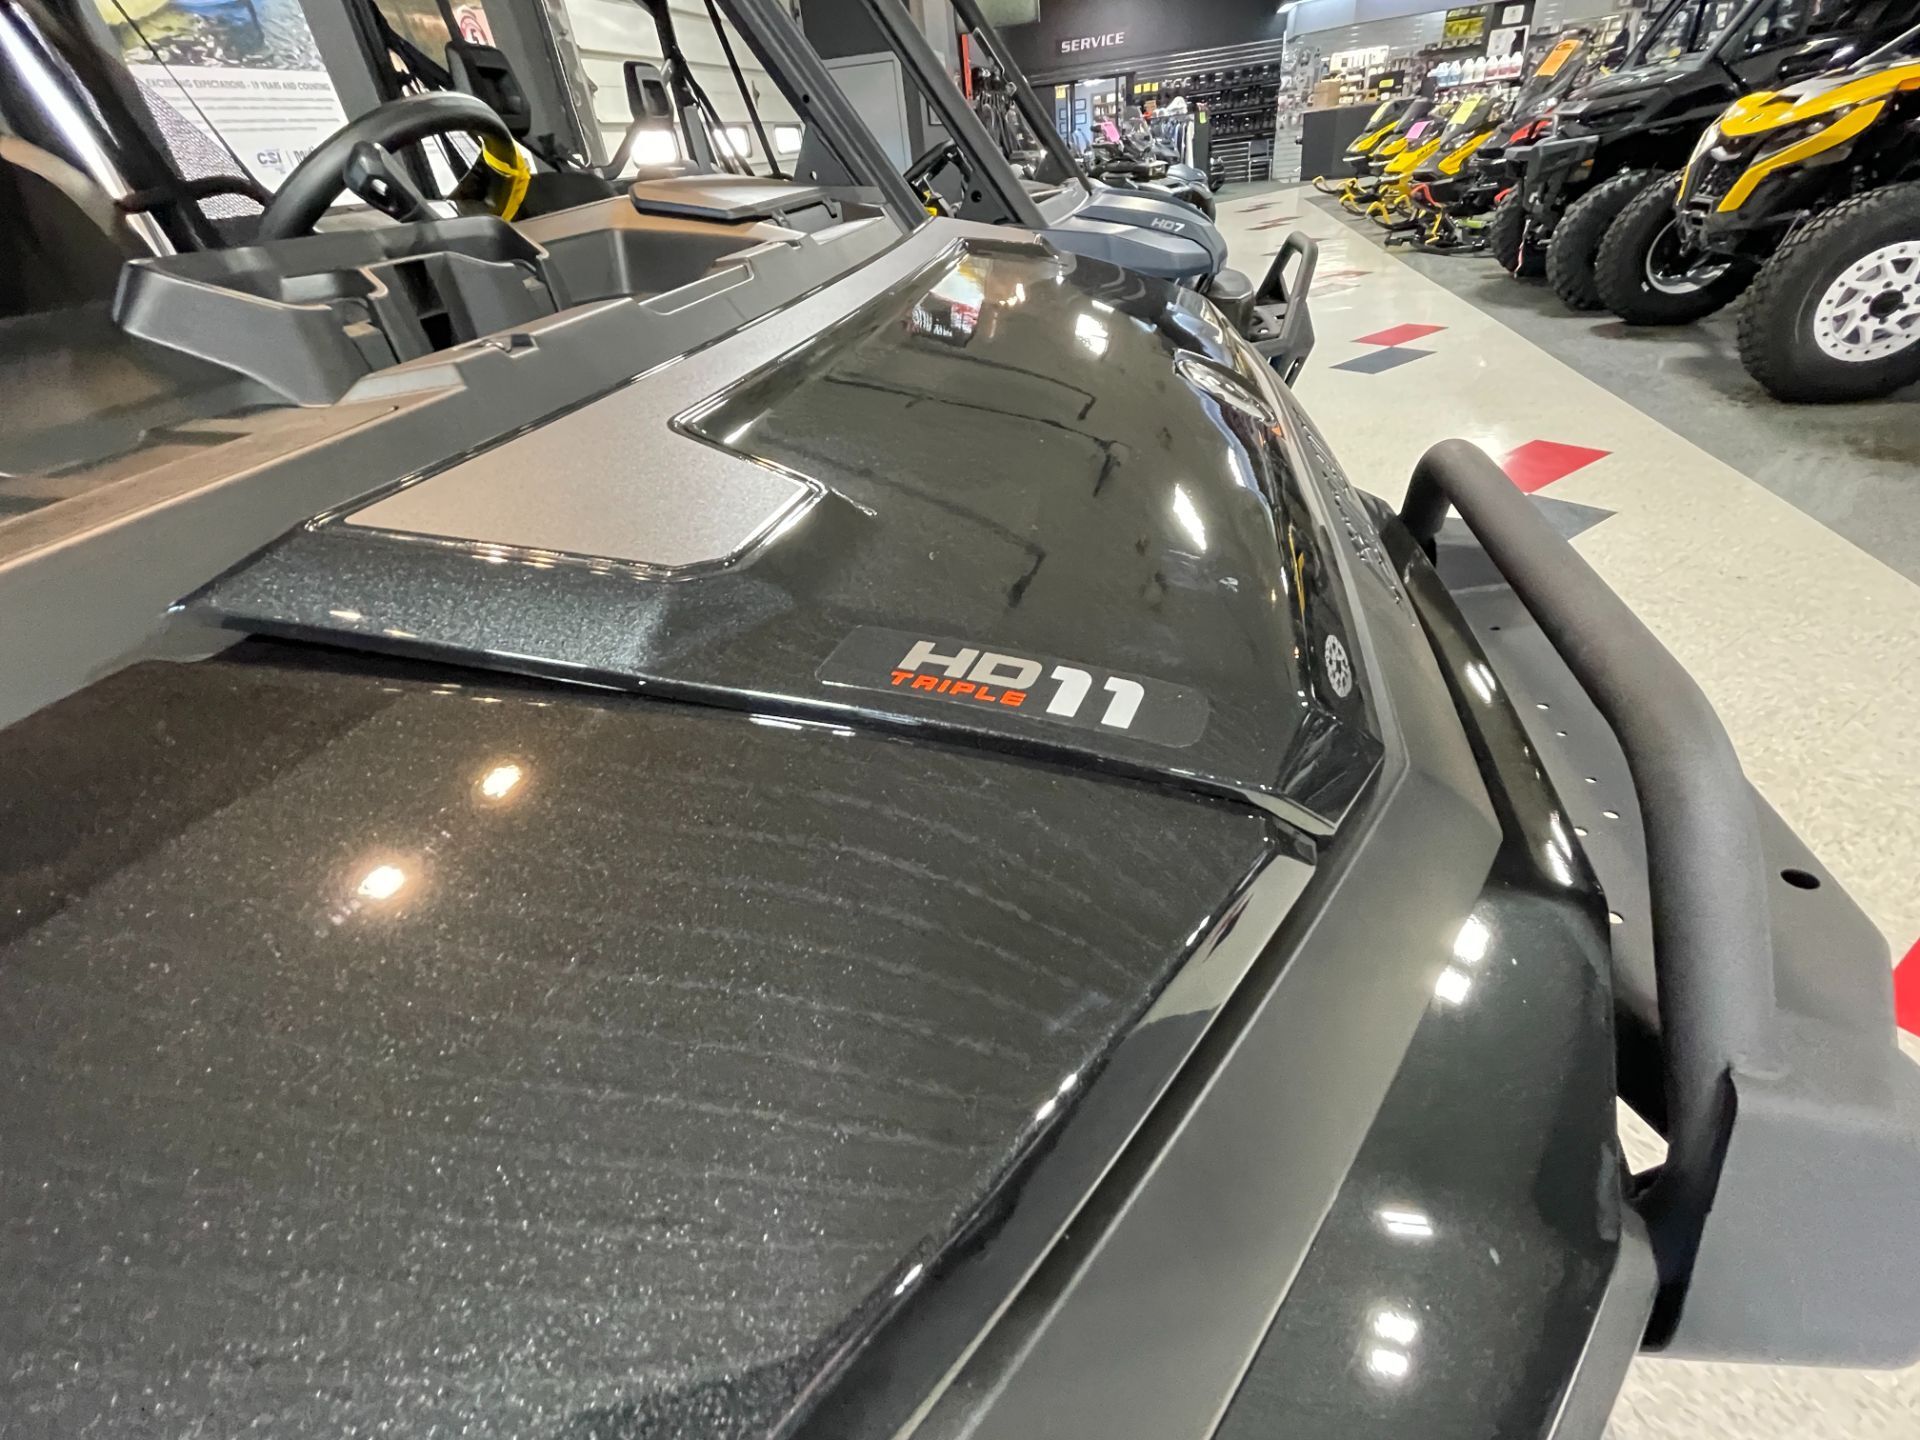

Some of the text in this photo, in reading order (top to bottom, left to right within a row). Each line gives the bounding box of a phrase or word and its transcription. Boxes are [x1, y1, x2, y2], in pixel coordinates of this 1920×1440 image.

[1061, 32, 1125, 53] SERVICE
[282, 82, 297, 90] AND
[1152, 218, 1185, 232] HD7
[890, 670, 1027, 707] TRIPLE
